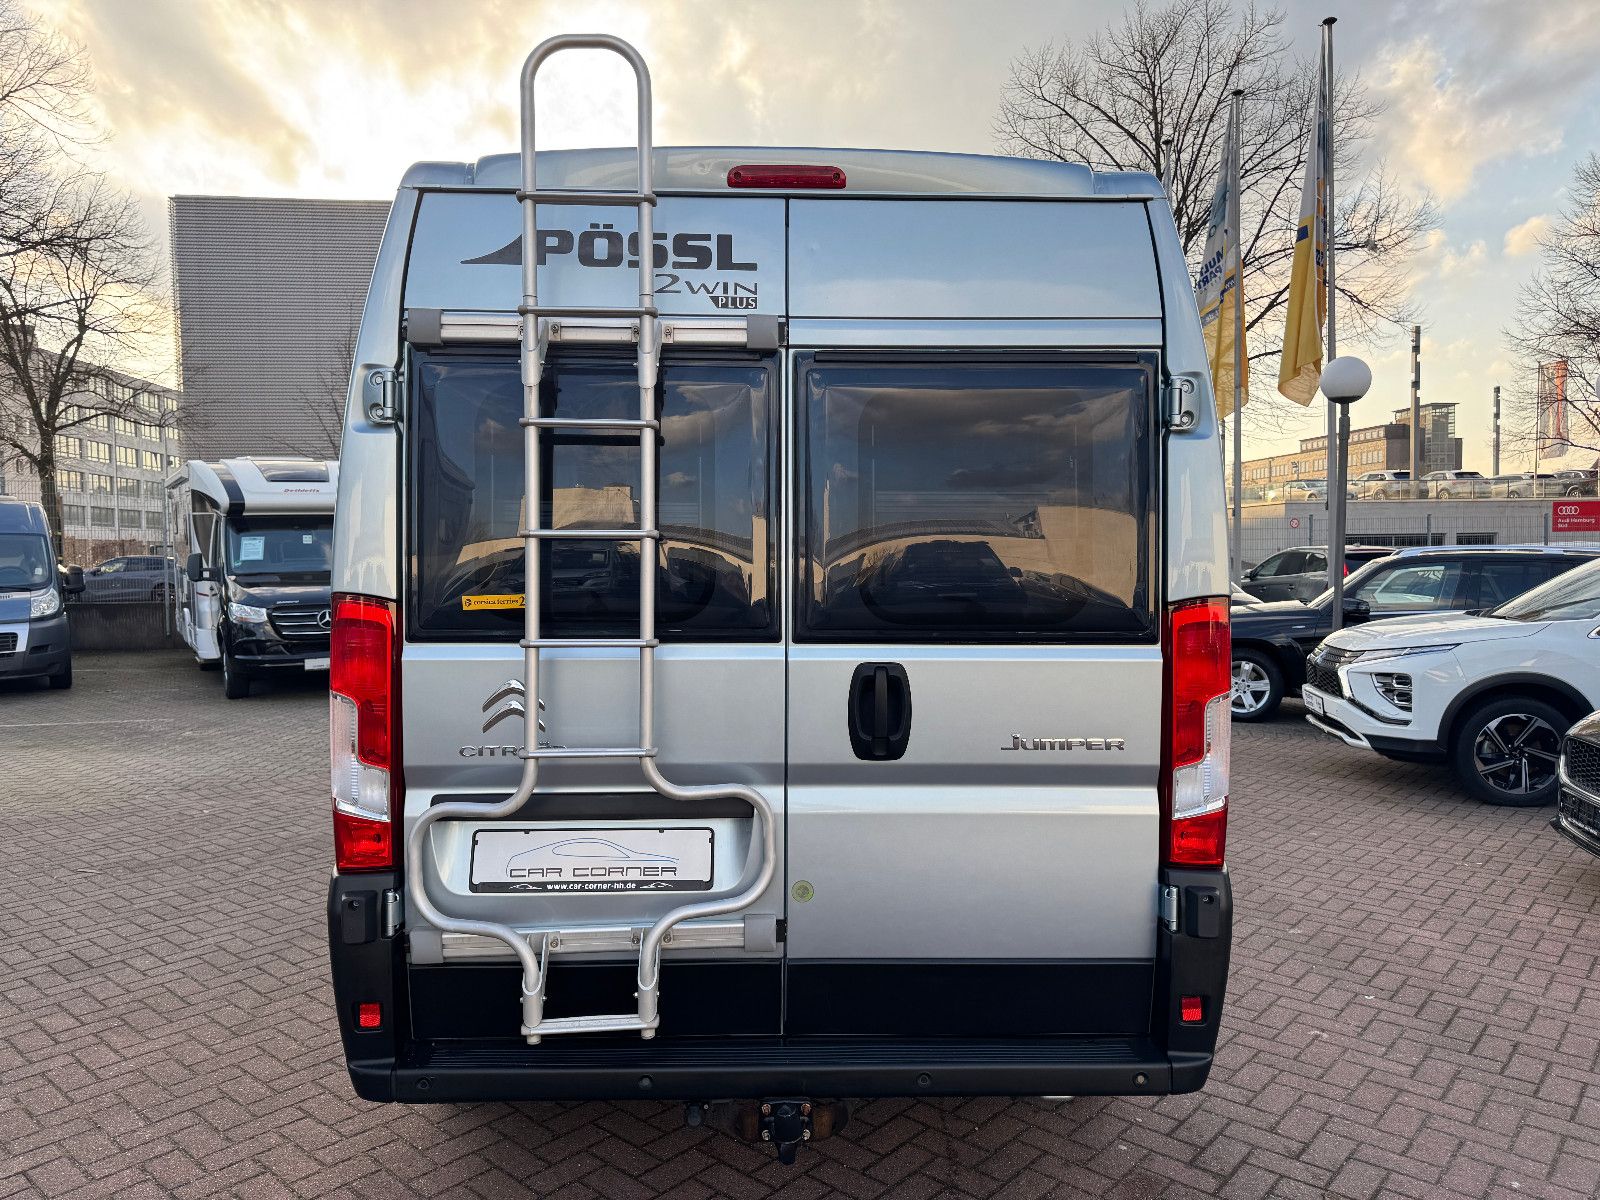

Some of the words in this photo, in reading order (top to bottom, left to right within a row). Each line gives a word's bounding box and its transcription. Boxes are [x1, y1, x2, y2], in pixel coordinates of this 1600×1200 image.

[536, 223, 758, 271] PÖSSL
[718, 296, 757, 309] PLUS
[509, 867, 563, 878] CAR
[572, 866, 678, 877] CORNER
[546, 882, 637, 891] www.car-corner-hh.de
